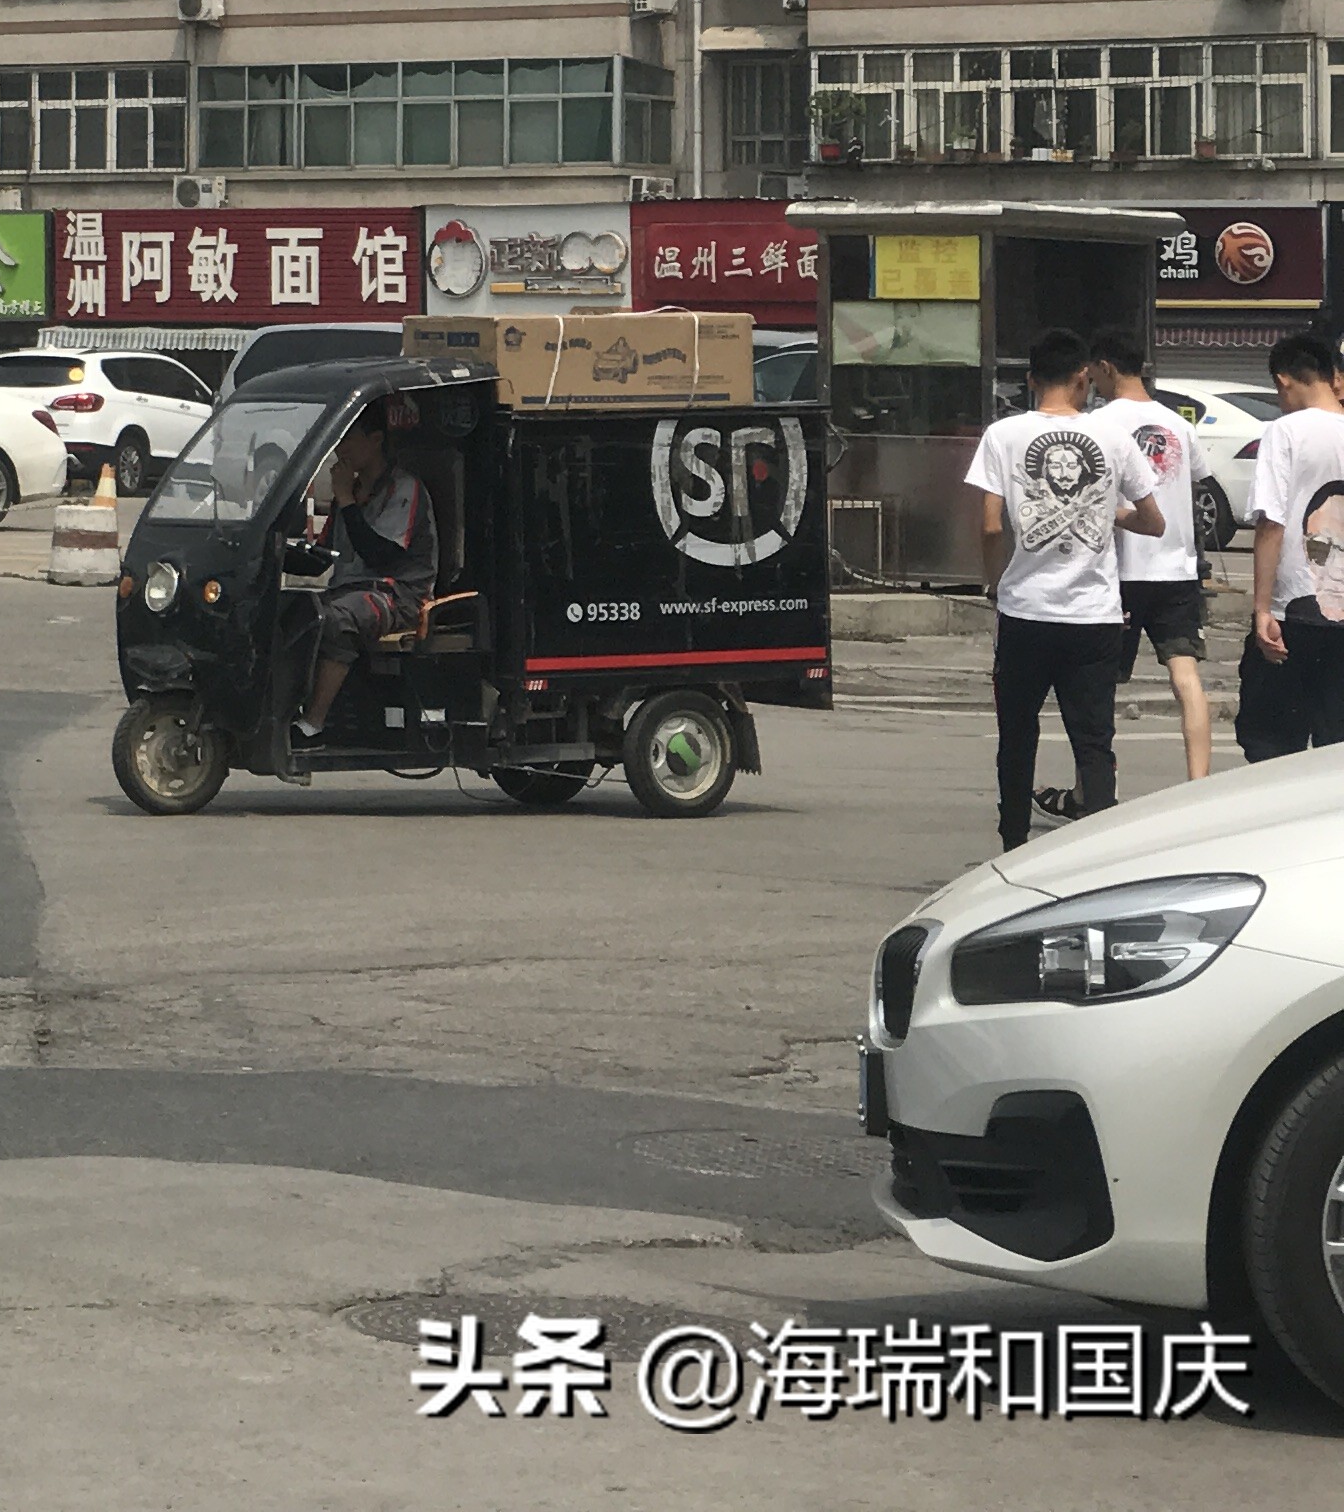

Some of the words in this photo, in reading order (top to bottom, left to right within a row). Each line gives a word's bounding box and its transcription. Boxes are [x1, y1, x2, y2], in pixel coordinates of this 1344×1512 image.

[64, 211, 107, 317] 温州
[120, 225, 408, 306] 阿敏面馆
[654, 239, 819, 284] 温州三鲜面
[1159, 264, 1200, 280] chain
[587, 602, 641, 622] 95338
[659, 597, 809, 616] www.sf-express.com
